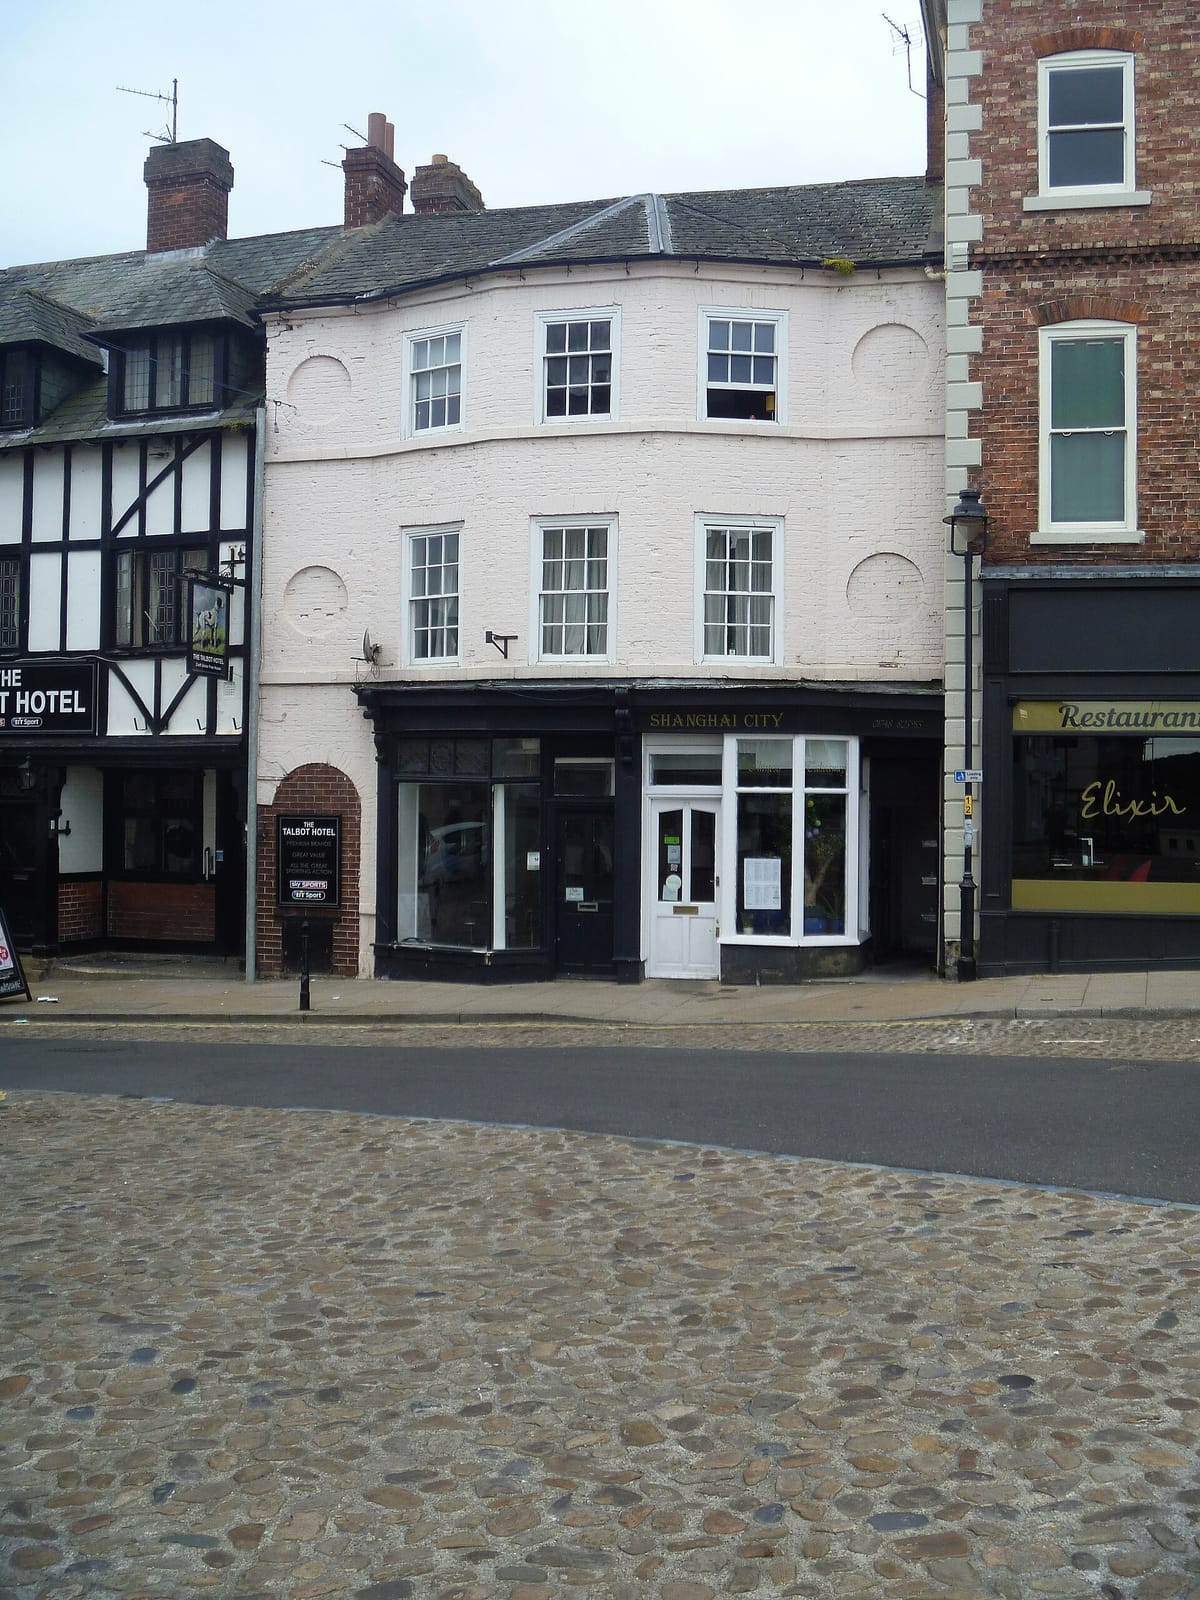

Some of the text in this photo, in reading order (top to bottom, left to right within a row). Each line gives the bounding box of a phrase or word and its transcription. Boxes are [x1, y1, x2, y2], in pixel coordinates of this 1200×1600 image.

[0, 669, 22, 687] HE
[16, 690, 86, 714] HOTEL
[650, 712, 784, 728] SHANGHAI CITY
[1081, 779, 1187, 824] Elixir
[282, 827, 336, 836] TALBOT HOTEL
